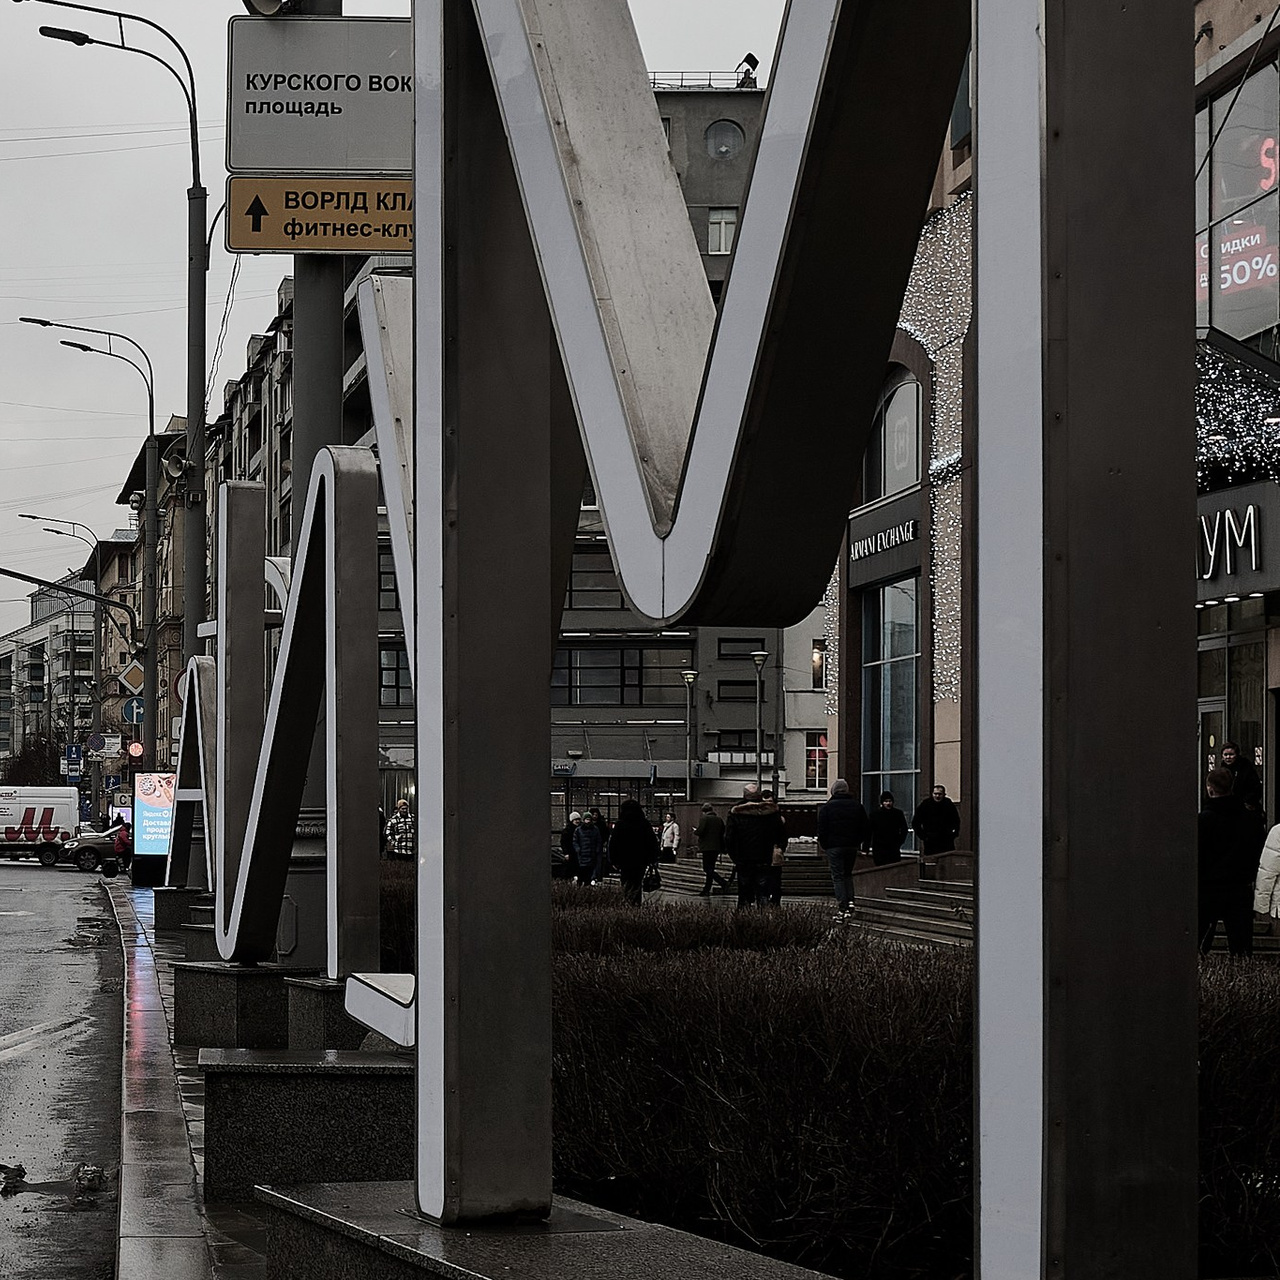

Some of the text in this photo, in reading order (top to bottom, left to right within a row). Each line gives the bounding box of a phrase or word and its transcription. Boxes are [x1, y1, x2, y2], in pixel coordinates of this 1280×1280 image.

[245, 73, 412, 93] КУРСКОГО ВОК
[245, 100, 343, 117] площадь
[284, 190, 370, 213] ВОРЛД
[1200, 232, 1261, 259] Сидки
[850, 520, 915, 561] ARMANI EXCHANGE
